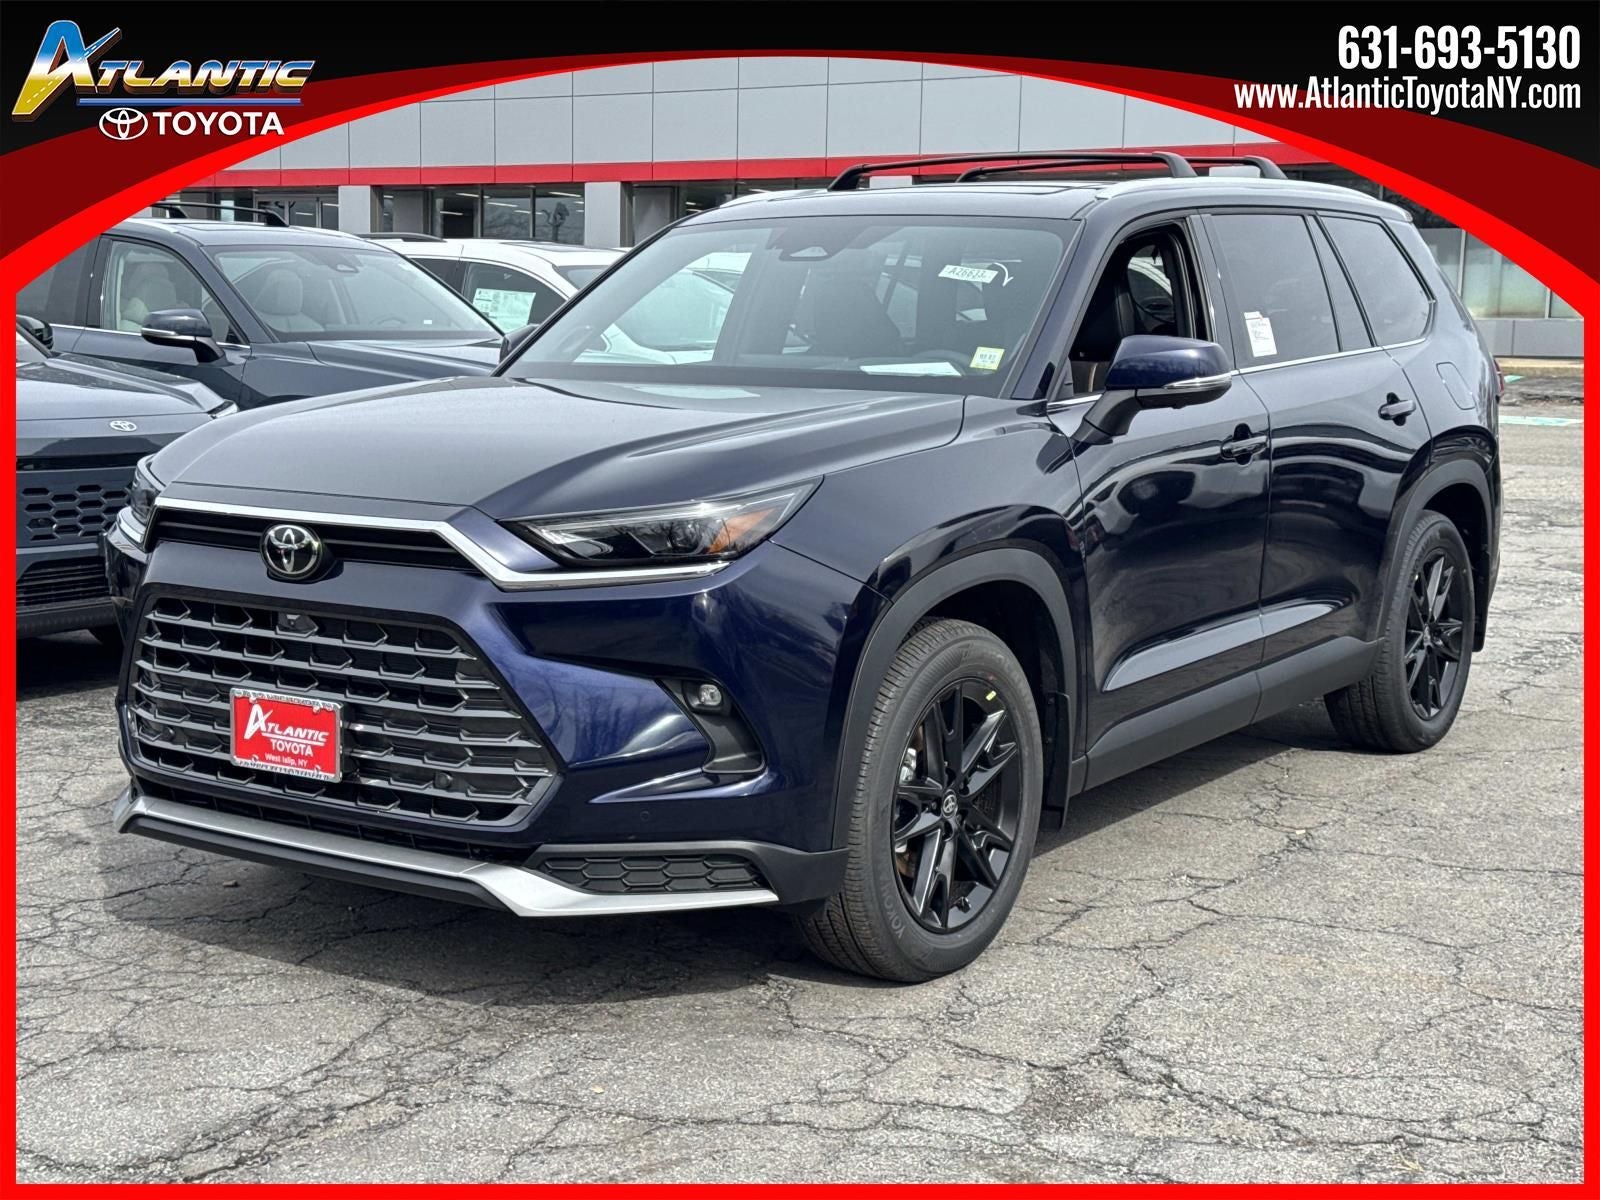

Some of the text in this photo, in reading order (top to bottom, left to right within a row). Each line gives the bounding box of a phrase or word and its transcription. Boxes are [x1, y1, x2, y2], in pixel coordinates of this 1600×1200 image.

[243, 703, 330, 741] ATLANTIC
[270, 739, 314, 757] TOYOTA
[298, 758, 309, 768] NY
